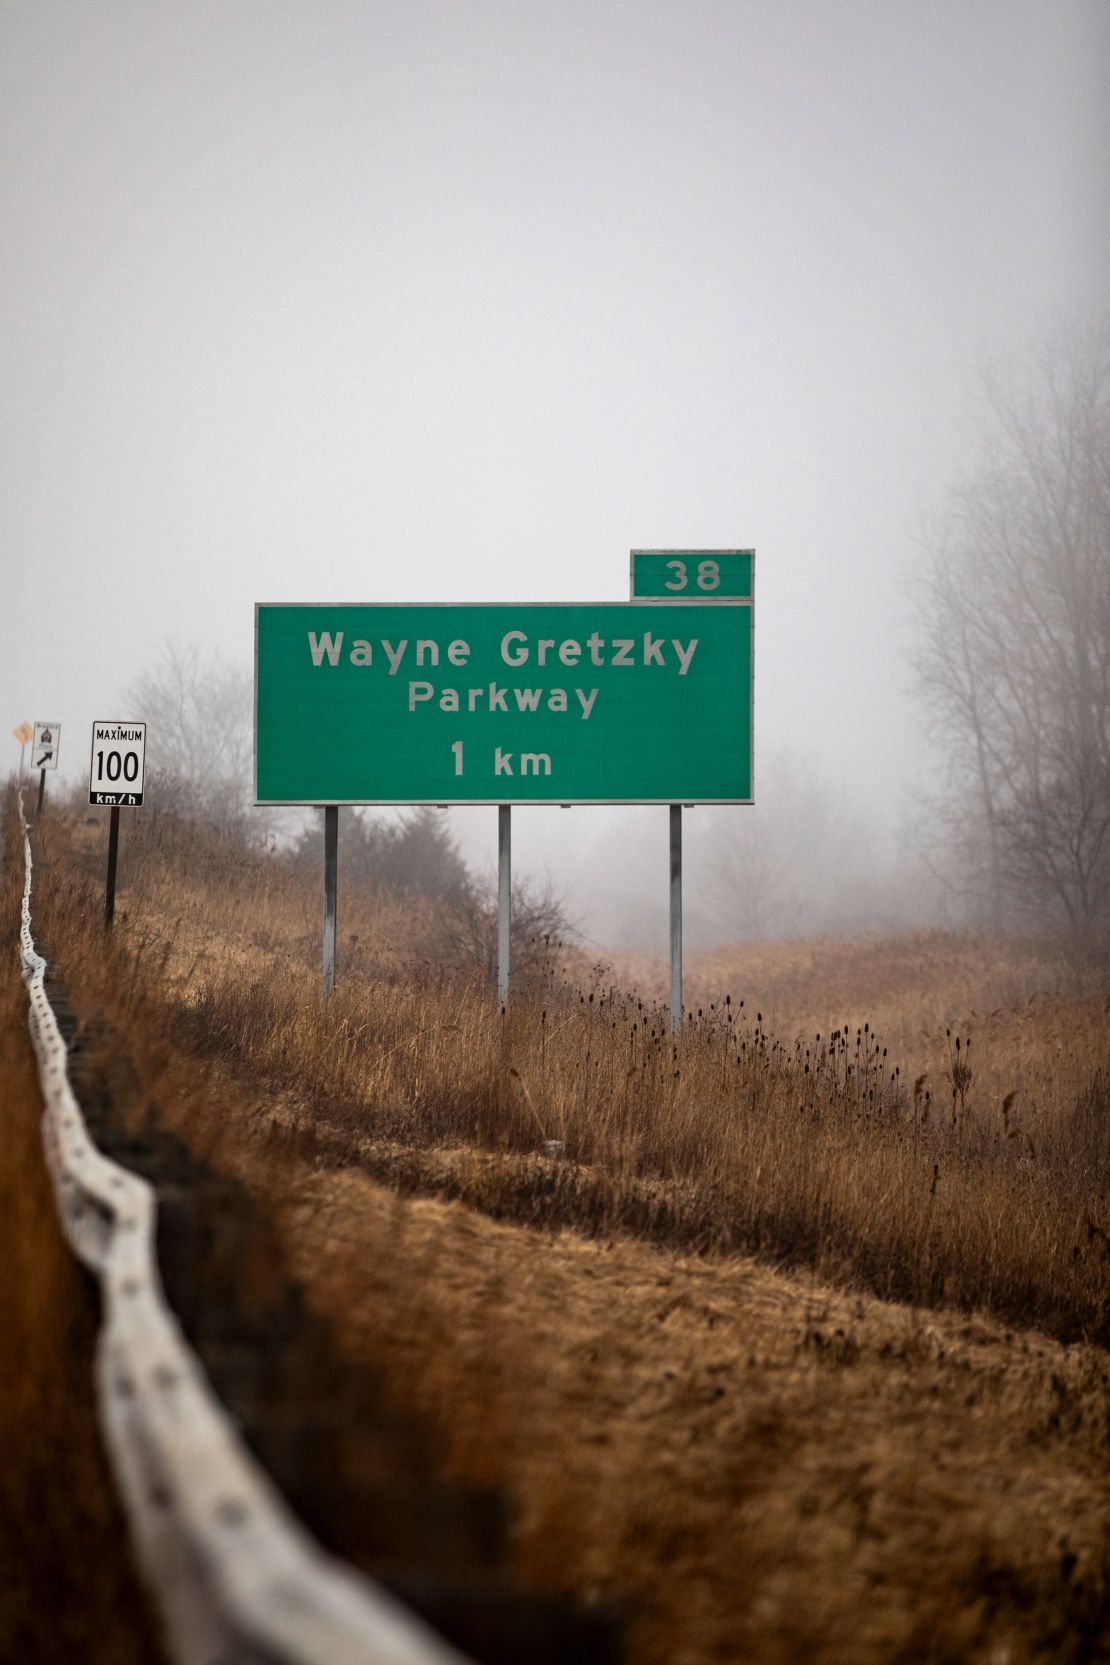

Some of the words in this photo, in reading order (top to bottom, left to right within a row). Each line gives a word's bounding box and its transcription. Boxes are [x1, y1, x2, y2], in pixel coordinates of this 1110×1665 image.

[665, 560, 721, 591] 38
[308, 631, 471, 675] Wayne
[501, 630, 698, 675] Gretzky
[409, 681, 598, 720] Parkway
[96, 729, 142, 741] MAXIMUM
[97, 751, 139, 782] 100
[451, 741, 463, 776] 1
[495, 748, 551, 776] km
[96, 793, 136, 805] km/h
